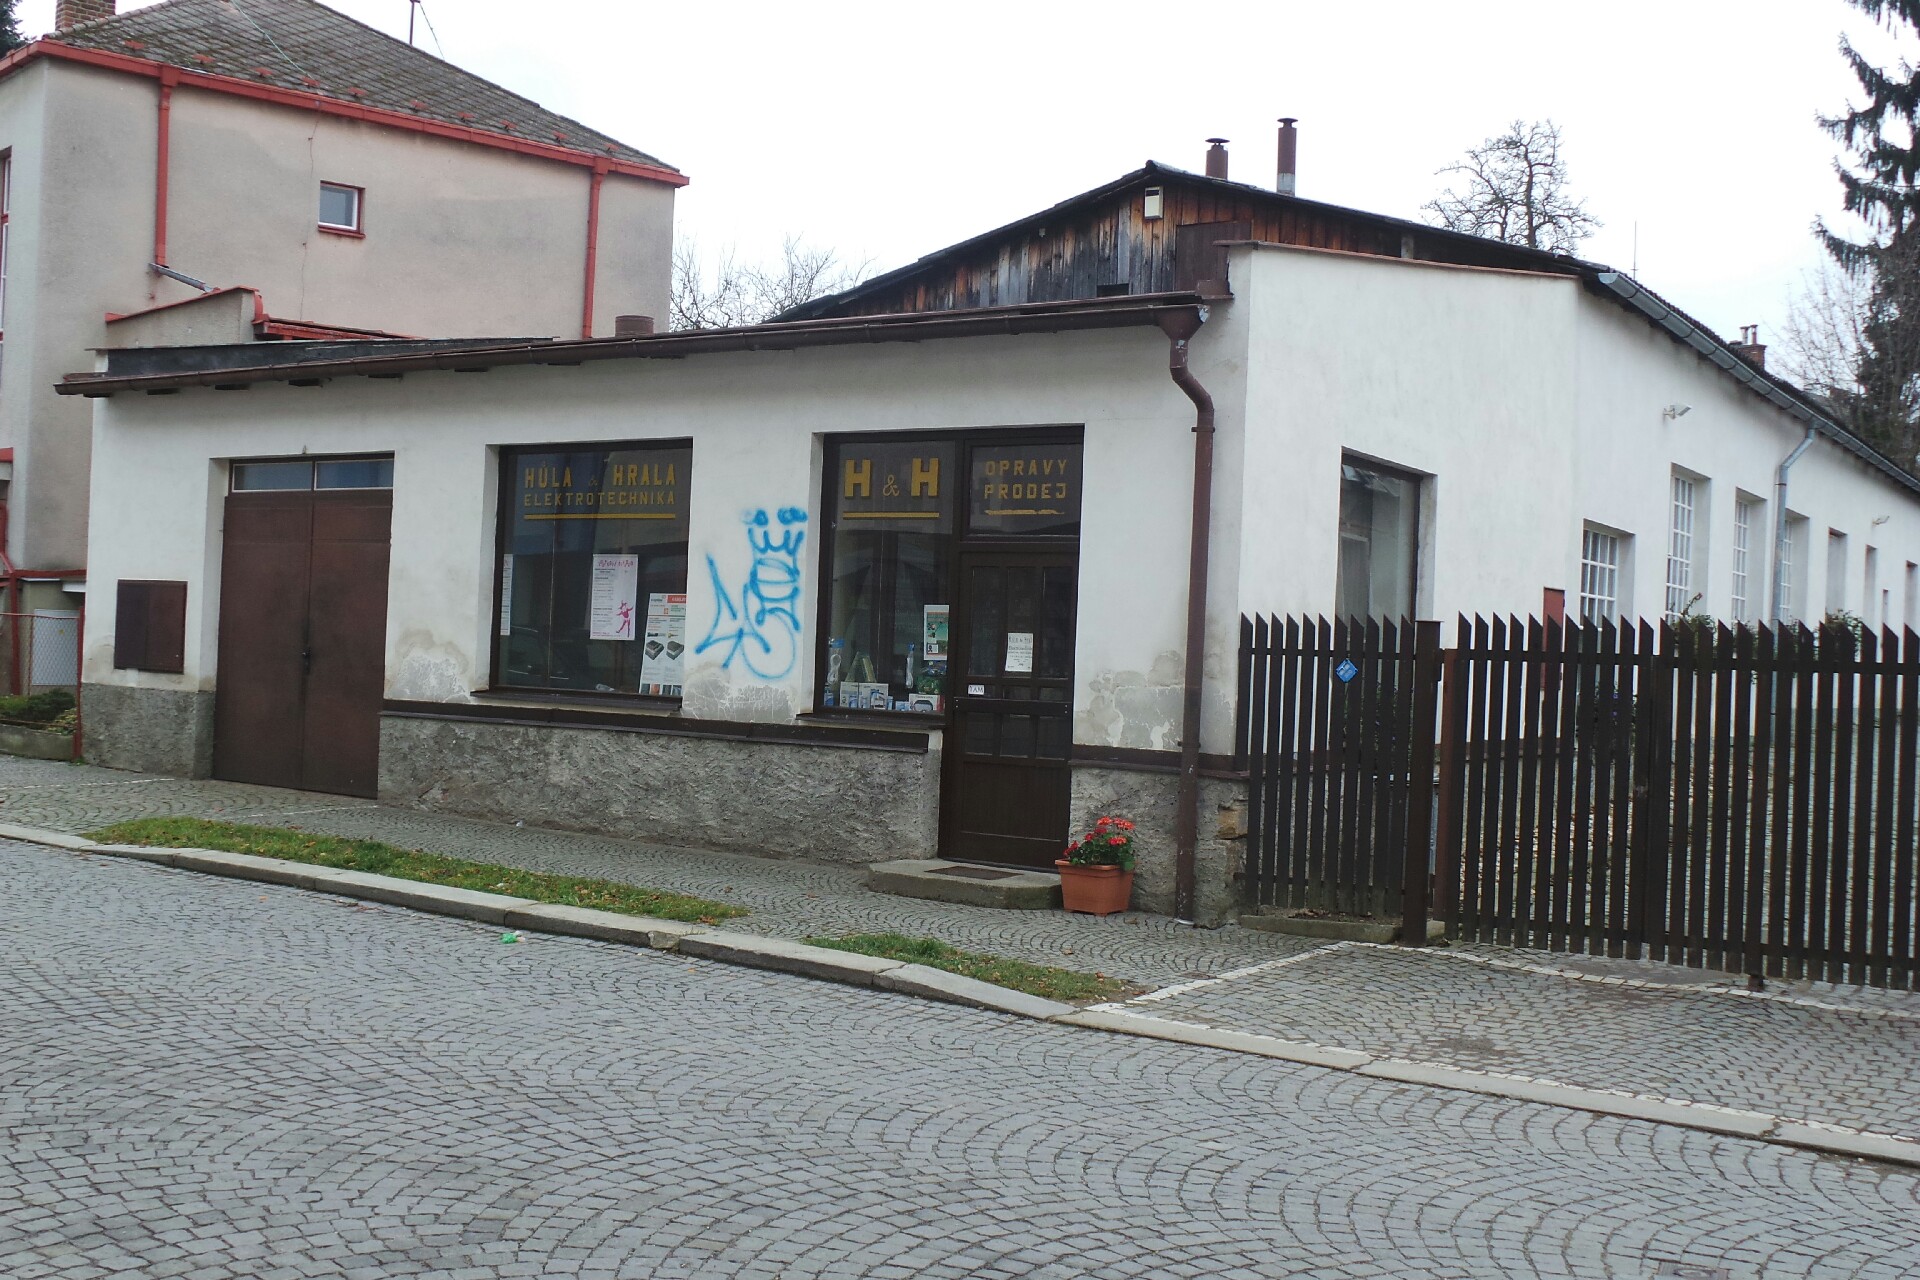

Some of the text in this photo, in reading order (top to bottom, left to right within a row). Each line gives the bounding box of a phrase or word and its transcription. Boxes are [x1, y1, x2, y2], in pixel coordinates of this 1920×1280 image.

[612, 463, 676, 486] HRALA
[985, 459, 1067, 476] OPRAVY
[845, 457, 939, 497] H & H
[524, 490, 675, 507] ELEKTROTECHNIKA
[984, 482, 1067, 500] PRODEJ
